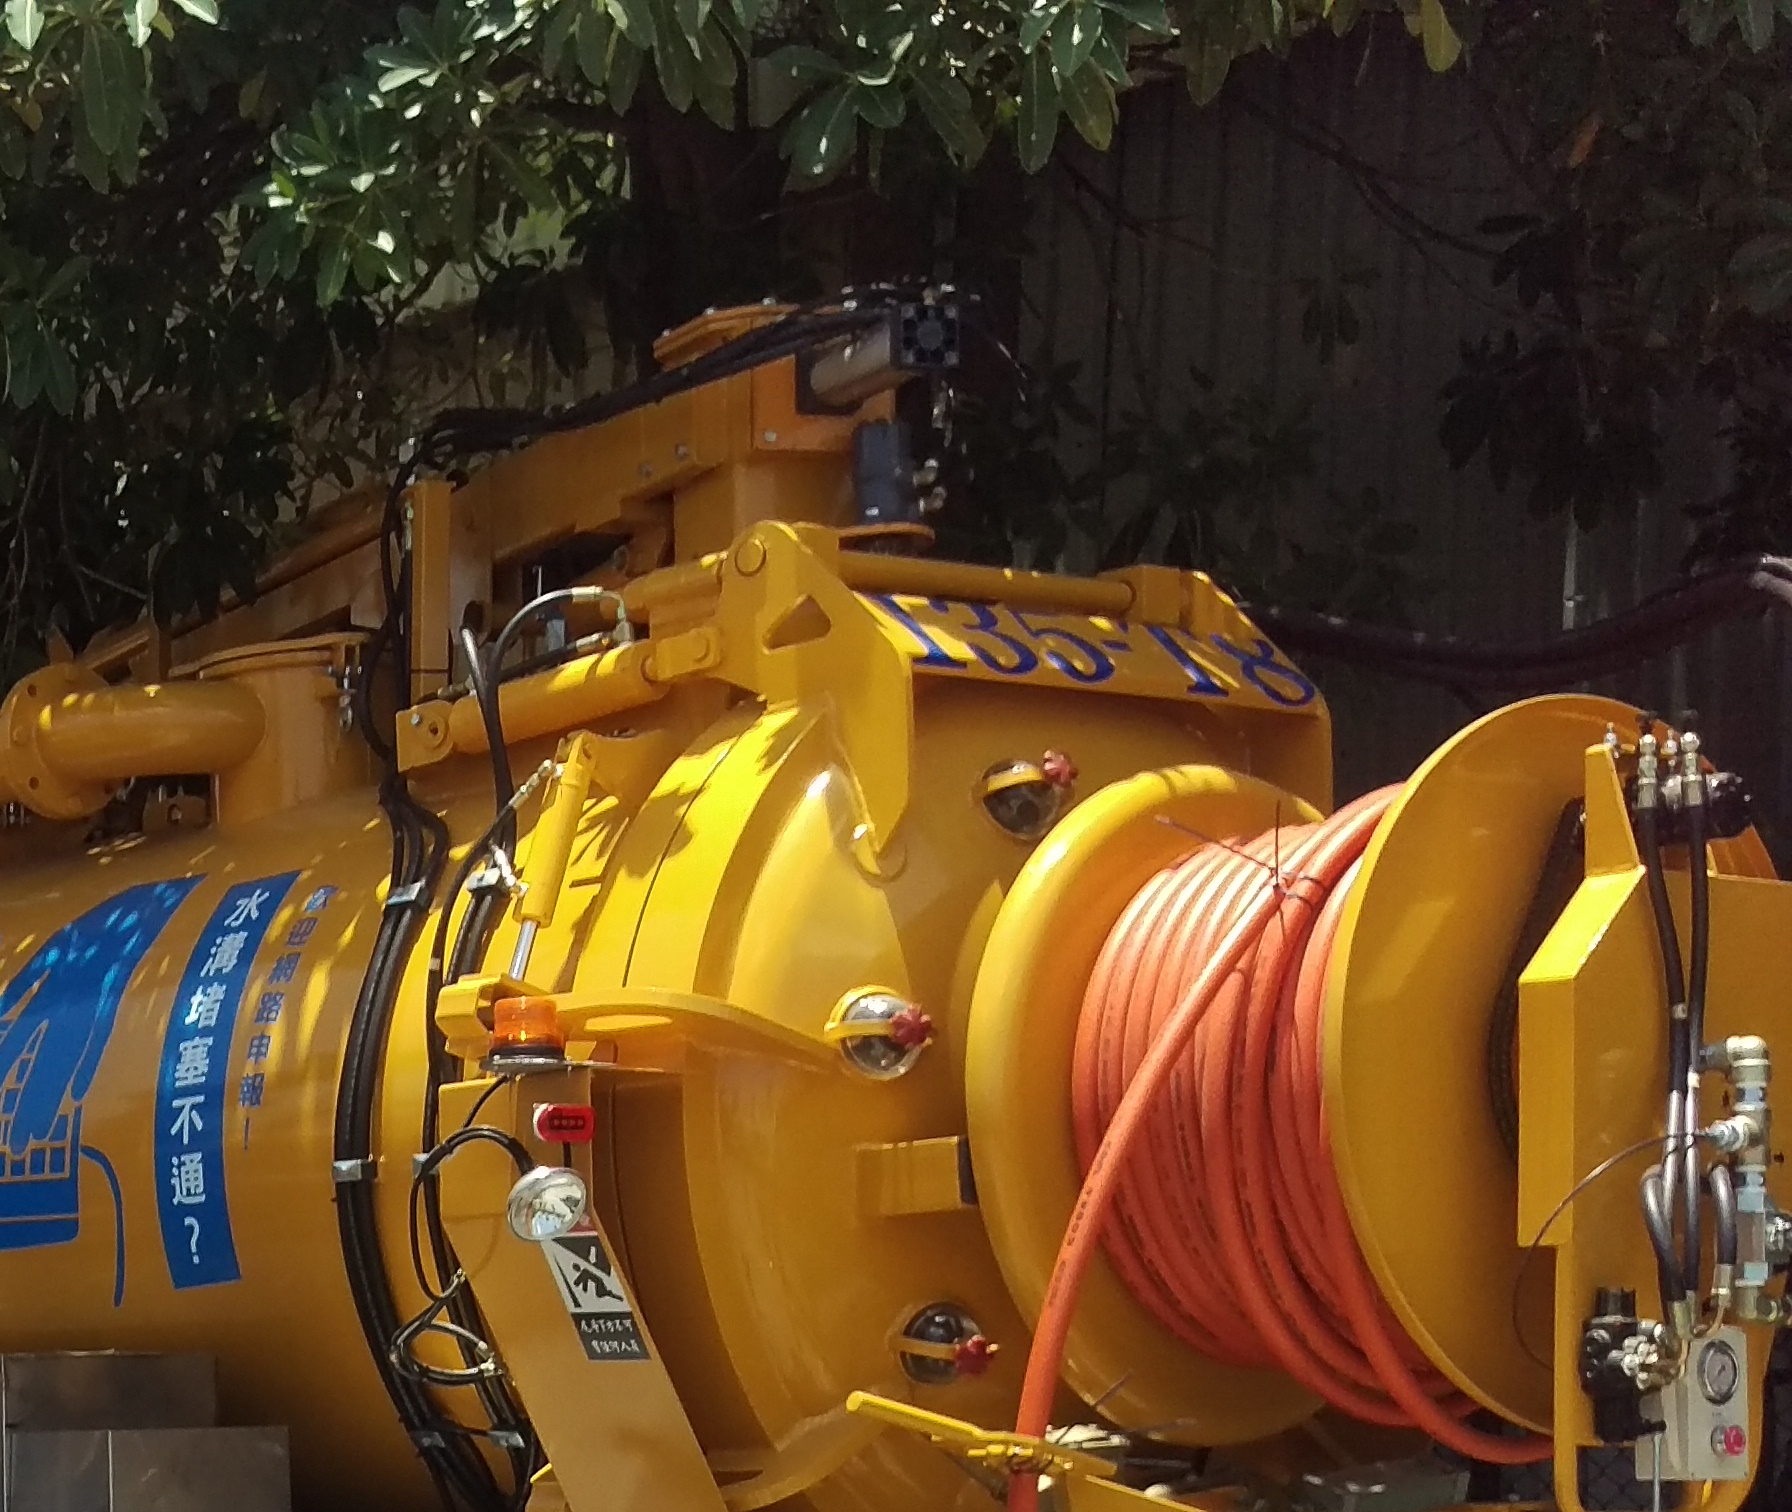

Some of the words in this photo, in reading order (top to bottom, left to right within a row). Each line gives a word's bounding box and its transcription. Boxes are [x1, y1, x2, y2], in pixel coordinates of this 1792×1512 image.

[170, 888, 269, 1264] 水溝堵塞不通？
